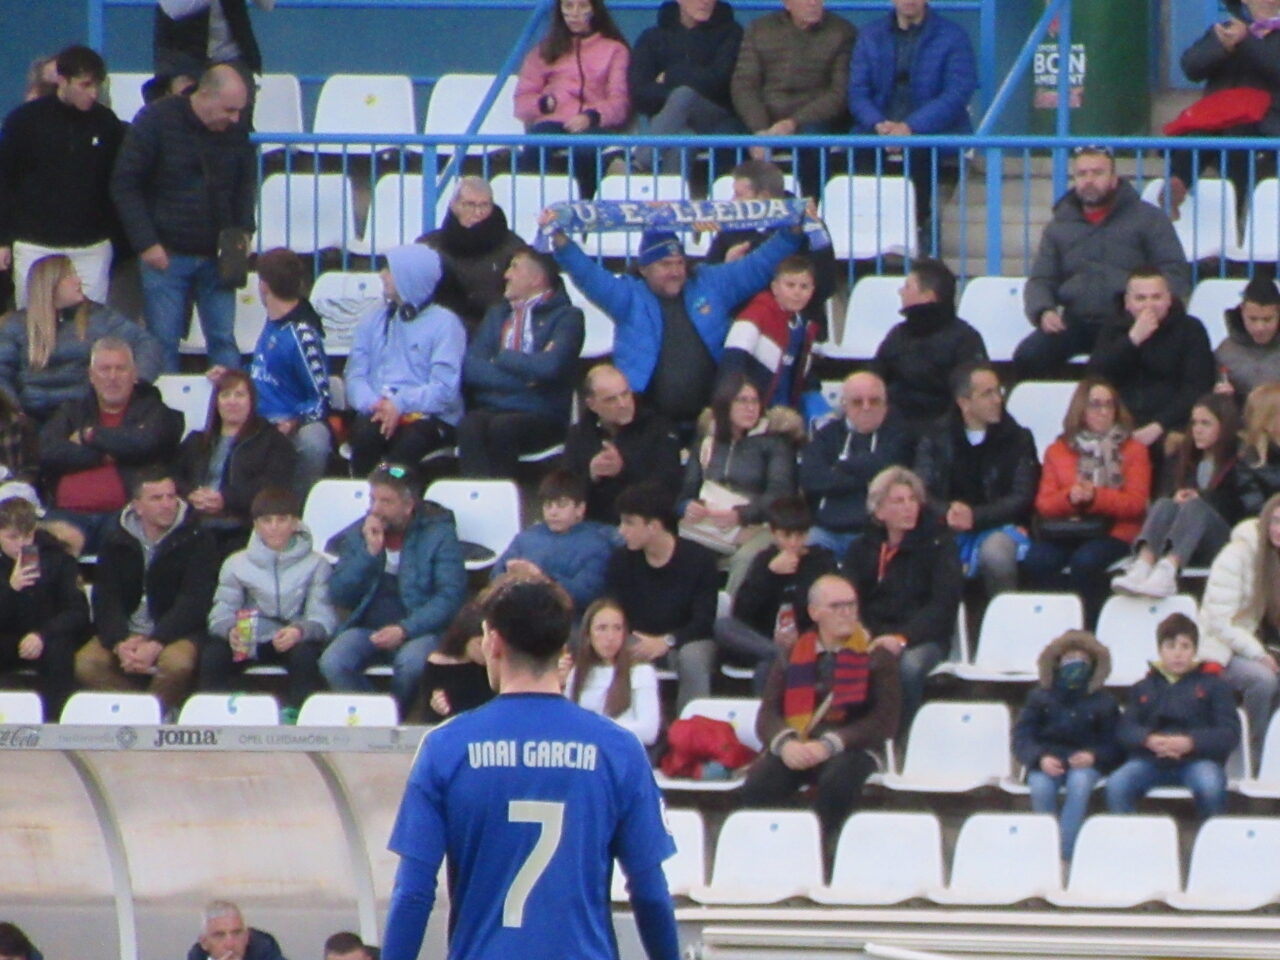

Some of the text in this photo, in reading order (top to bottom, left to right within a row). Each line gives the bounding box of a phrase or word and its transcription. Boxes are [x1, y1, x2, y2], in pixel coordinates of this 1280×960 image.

[671, 199, 790, 223] LLEIDA
[467, 740, 598, 771] UNAI GARCIA
[502, 800, 564, 928] 7
